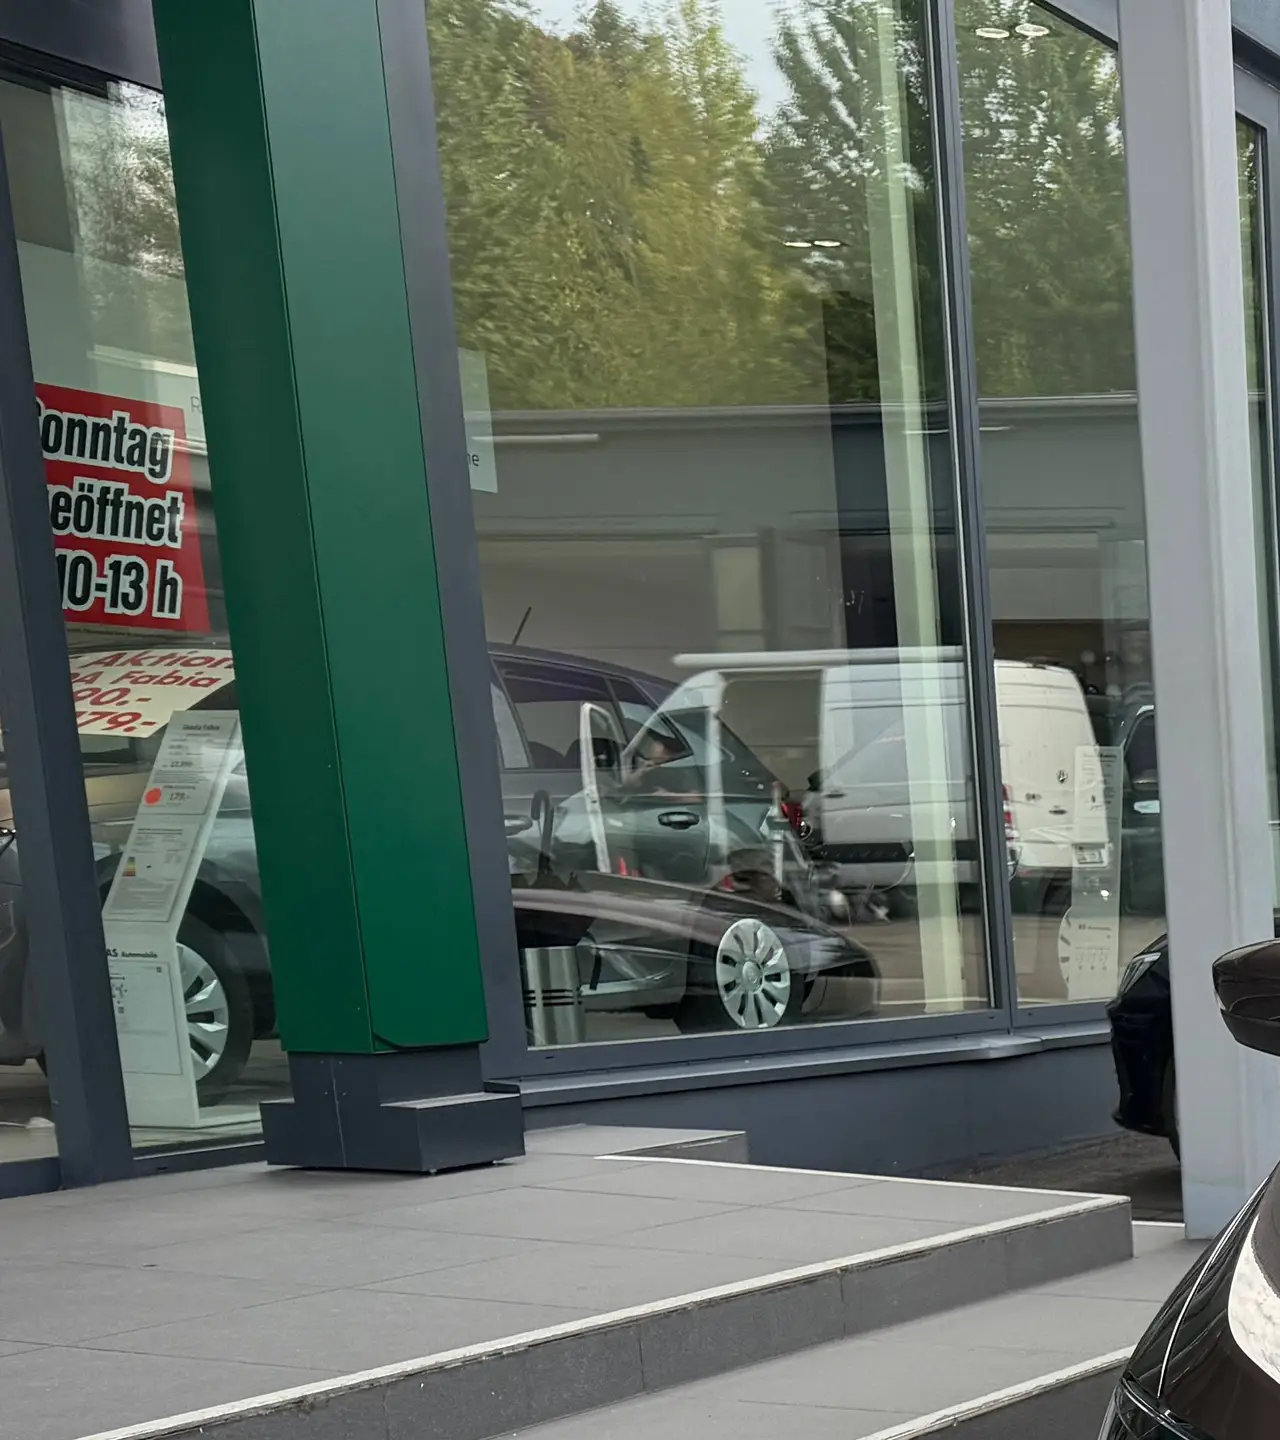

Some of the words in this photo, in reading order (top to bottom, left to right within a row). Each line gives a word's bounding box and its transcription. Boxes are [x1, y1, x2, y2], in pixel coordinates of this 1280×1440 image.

[36, 399, 171, 480] onntag
[49, 482, 182, 544] eöffnet
[156, 565, 178, 614] h
[109, 670, 222, 687] Fabia
